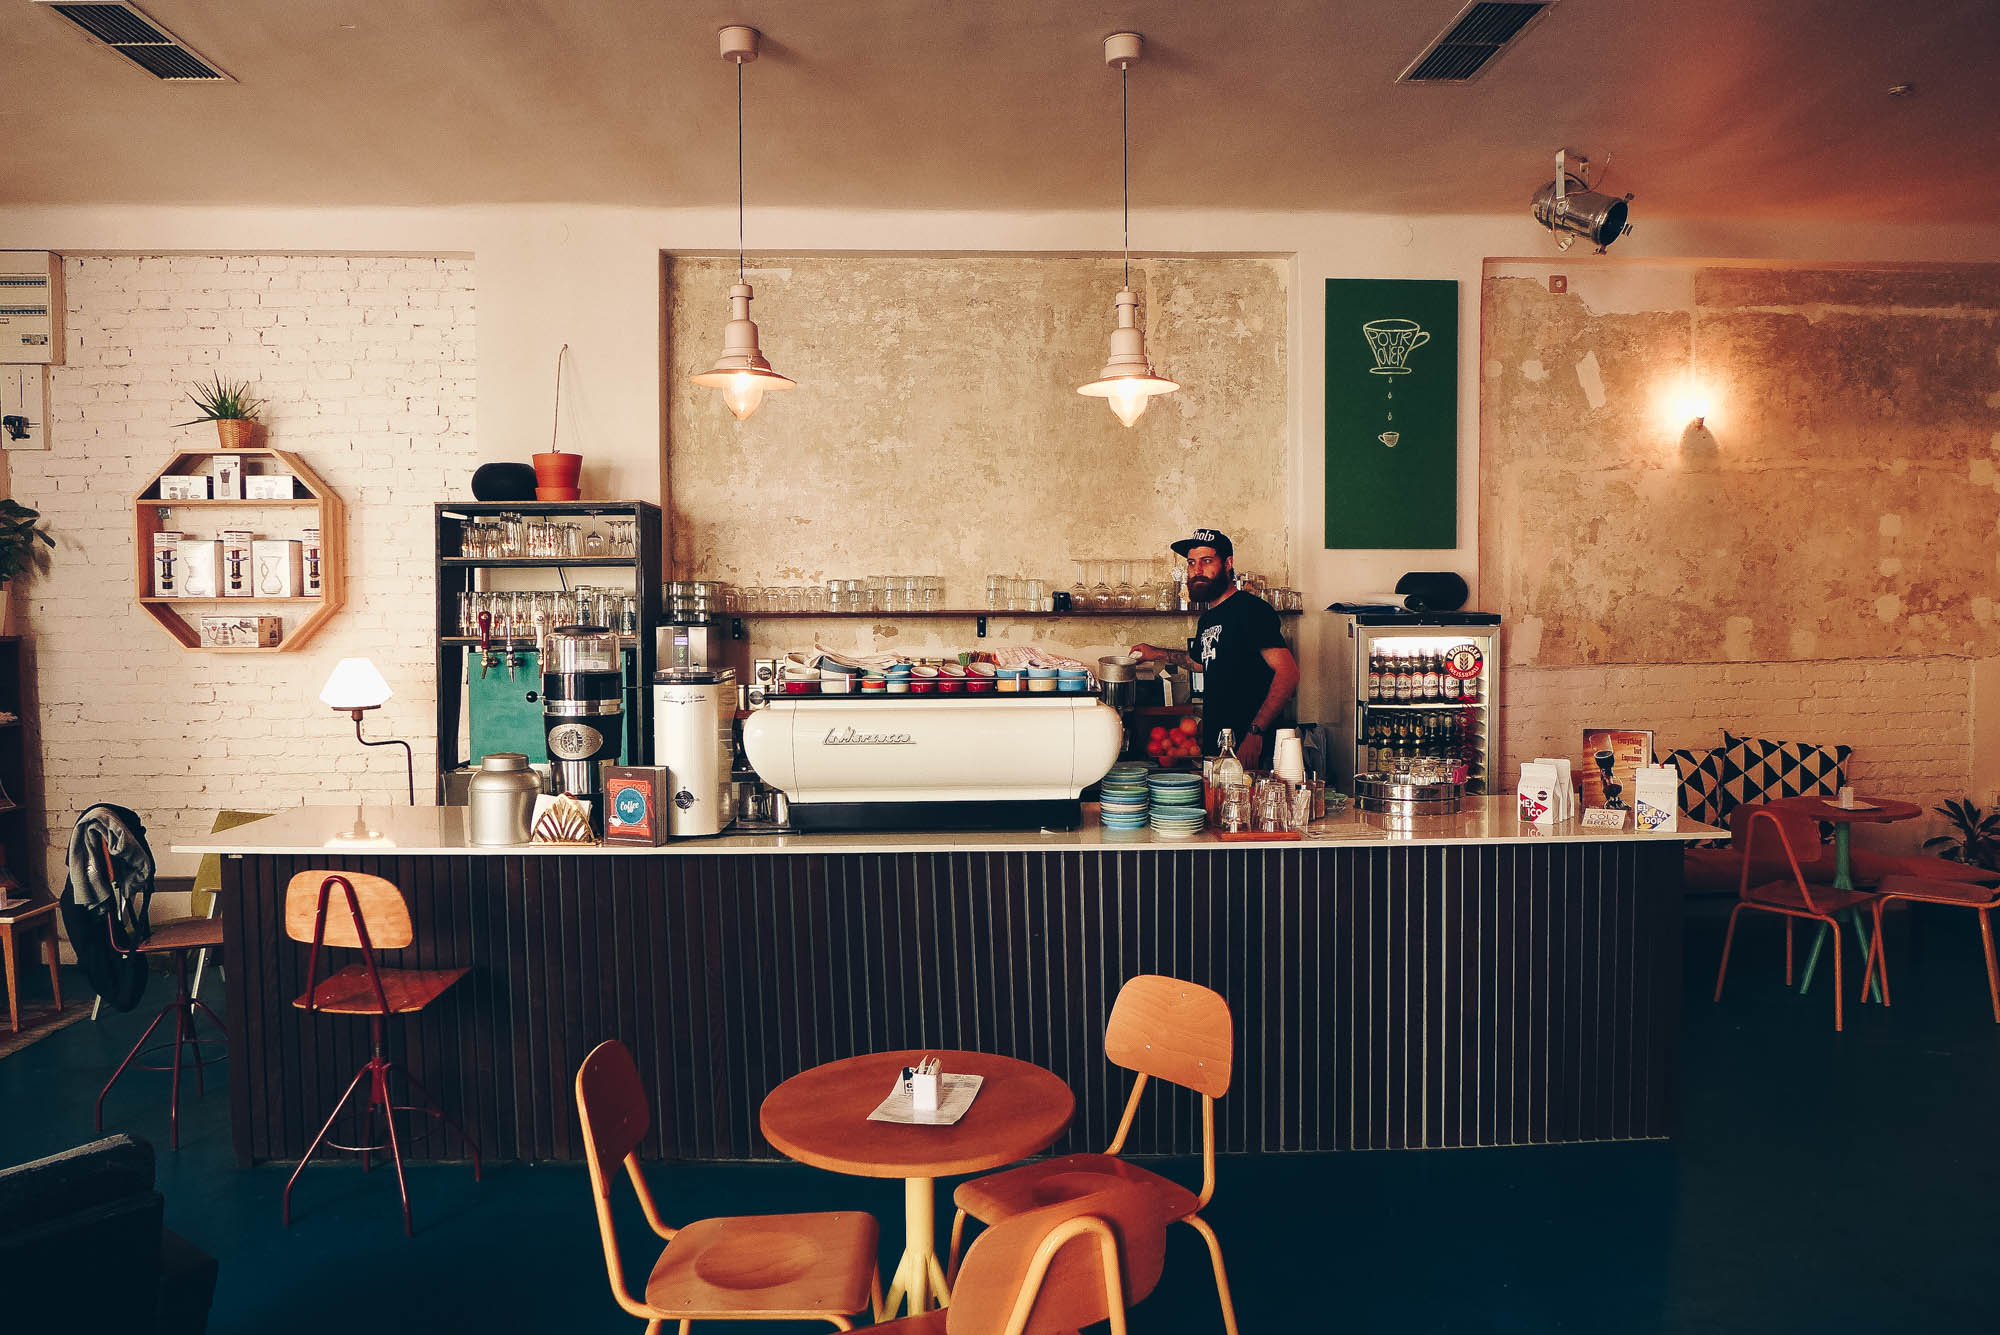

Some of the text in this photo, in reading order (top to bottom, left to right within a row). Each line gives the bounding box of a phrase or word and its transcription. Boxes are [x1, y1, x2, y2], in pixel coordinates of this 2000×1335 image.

[1367, 329, 1412, 350] POUR
[1377, 345, 1405, 366] OVER
[1447, 645, 1480, 660] ERDINGER
[620, 800, 640, 814] Coffee
[1527, 808, 1543, 817] ICO
